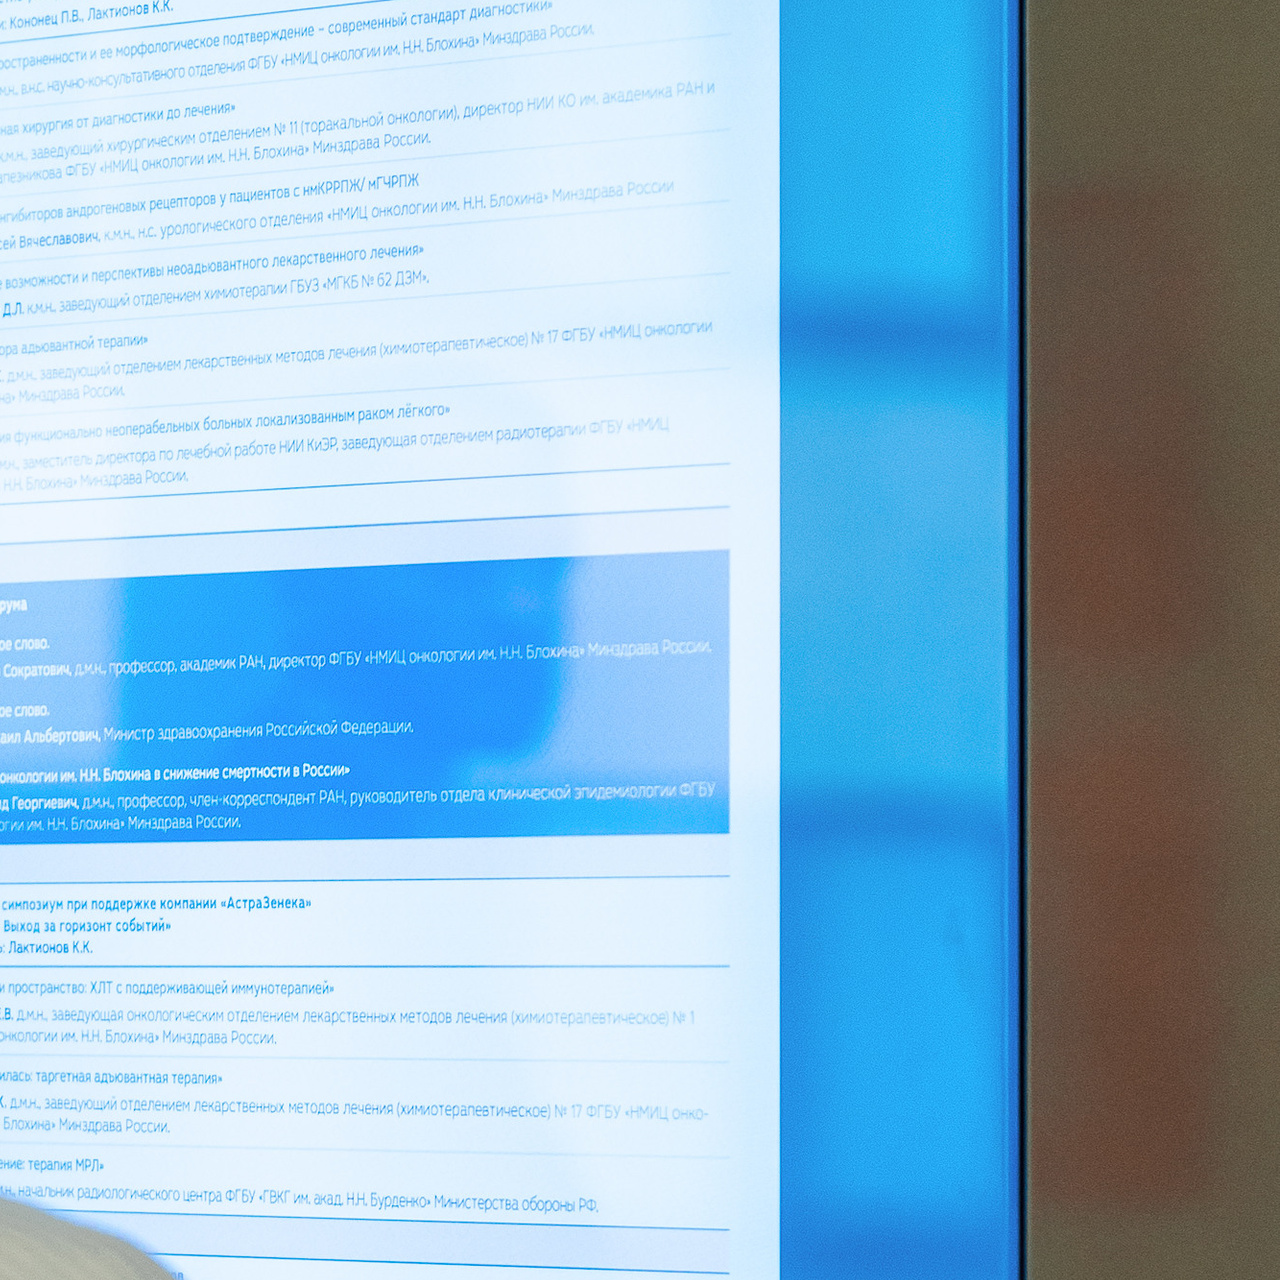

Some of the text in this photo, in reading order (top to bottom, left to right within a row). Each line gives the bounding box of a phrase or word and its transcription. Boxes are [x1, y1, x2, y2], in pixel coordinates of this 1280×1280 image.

[9, 14, 59, 29] Кононец
[87, 3, 149, 21] Лактионов
[115, 36, 220, 58] морфологическое
[222, 26, 315, 46] подтверждение
[327, 13, 408, 35] современный
[410, 8, 467, 25] стандарт
[65, 201, 146, 218] андрогеновых
[149, 194, 217, 212] рецепторов
[229, 187, 291, 203] пациентов
[5, 273, 79, 289] возможности
[91, 266, 164, 283] перспективы
[271, 249, 367, 268] лекарственного
[103, 727, 155, 742] Министр
[157, 725, 263, 741] здравоохранения
[265, 719, 338, 737] Российской
[103, 767, 152, 782] Блохина
[162, 767, 220, 780] снижение
[222, 765, 291, 780] смертности
[1, 900, 64, 913] симпозиум
[66, 899, 88, 913] при
[91, 899, 157, 912] поддержке
[159, 898, 217, 910] компании
[3, 919, 41, 934] Выход
[59, 921, 112, 934] горизонт
[8, 940, 70, 954] Лактионов
[7, 982, 87, 996] пространство:
[89, 979, 114, 994] ХЛТ
[125, 980, 228, 996] поддерживающей
[35, 1071, 92, 1084] таргетная
[27, 1159, 73, 1173] терапия
